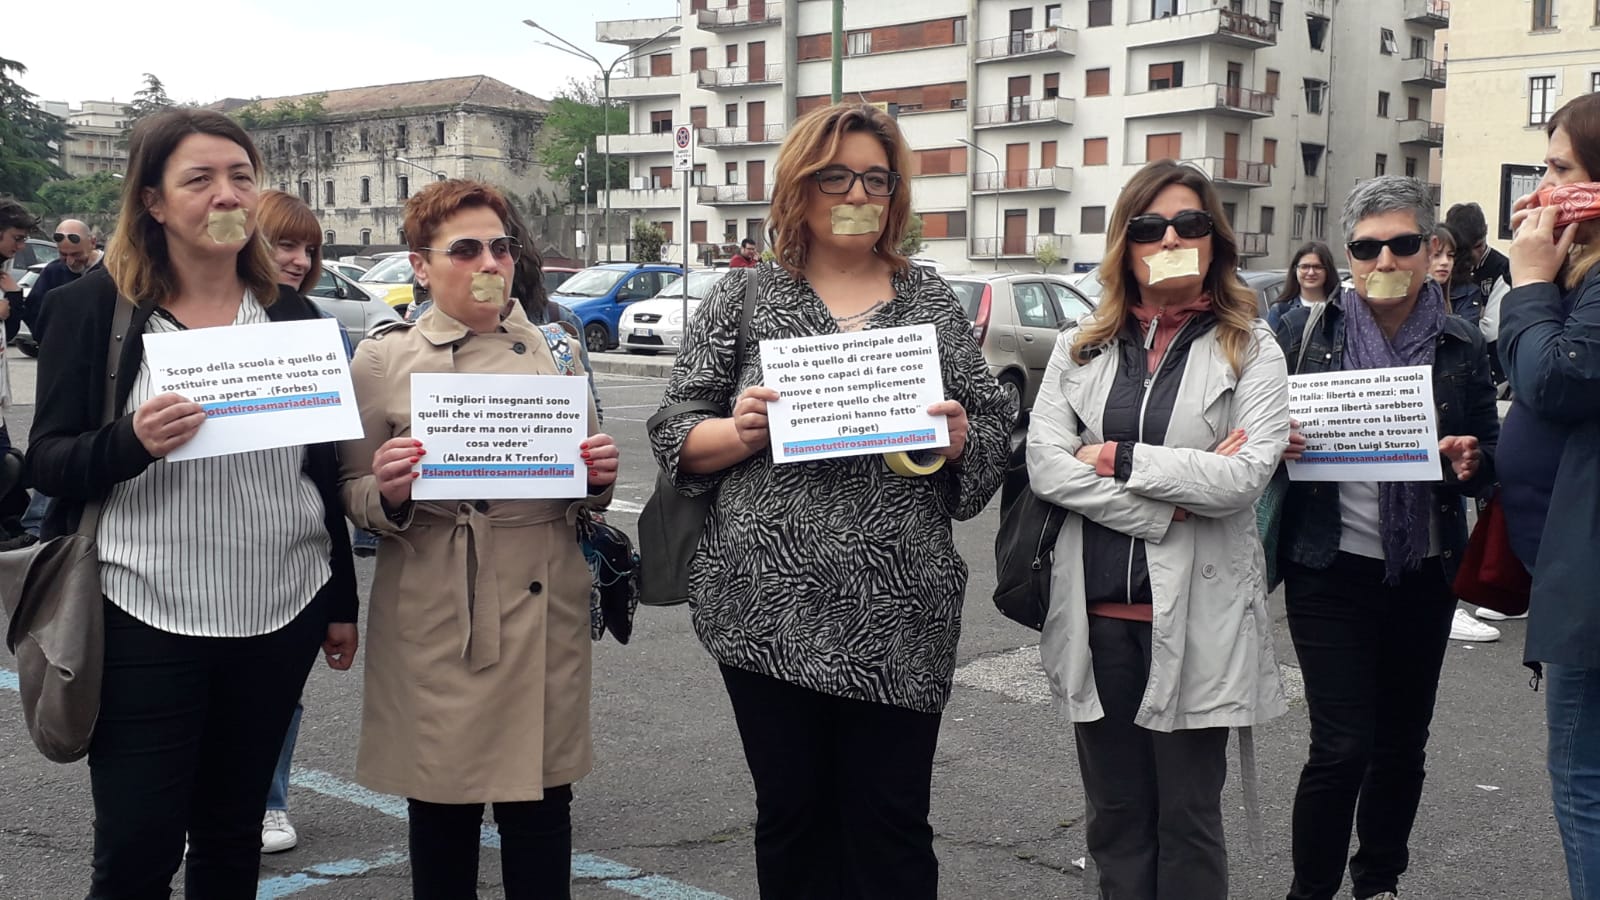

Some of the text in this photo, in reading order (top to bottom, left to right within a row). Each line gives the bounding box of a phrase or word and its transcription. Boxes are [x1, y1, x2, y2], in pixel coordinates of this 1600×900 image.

[792, 342, 839, 354] obiettivo
[843, 336, 894, 351] principale
[897, 333, 922, 343] della
[159, 352, 336, 377] "Scopo della scuola è quello di
[767, 346, 932, 370] scuola è quello di creare uomini
[161, 367, 341, 392] sostituire una mente vuota con
[779, 362, 924, 383] che sono capaci di fare cose
[1331, 378, 1371, 386] mancano
[1374, 375, 1391, 383] alla
[1394, 373, 1424, 382] scuola
[194, 383, 318, 402] una aperta" .(Forbes)
[780, 387, 812, 397] nuove
[824, 384, 844, 394] non
[847, 376, 926, 392] semplicemente
[429, 394, 570, 407] "I migliori insegnanti sono
[792, 391, 917, 412] ripetere quello che altre
[1290, 394, 1298, 402] in
[1300, 392, 1324, 401] Italia:
[1326, 390, 1356, 399] libertà
[1366, 388, 1397, 397] mezzi;
[202, 396, 341, 416] otuttirosamariadellaria
[1288, 400, 1423, 415] mezzi senza libertà sarebbero
[418, 409, 580, 421] quelli che vi mostreranno dove
[790, 404, 921, 427] generazioni hanno fatto"
[1300, 417, 1319, 429] pati
[1327, 417, 1361, 426] mentre
[1383, 413, 1392, 423] la
[1394, 412, 1426, 422] libertà
[427, 424, 476, 435] guardare
[499, 426, 518, 434] non
[521, 425, 530, 434] vi
[534, 425, 572, 434] diranno
[838, 423, 879, 436] (Piaget)
[1348, 428, 1376, 437] anche
[1387, 426, 1423, 435] trovare
[466, 438, 533, 448] cosa vedere"
[783, 432, 936, 454] #siamotuttirosamariadellaria
[1334, 441, 1356, 452] (Don
[1359, 441, 1382, 452] Luigi
[1384, 440, 1420, 449] Sturzo)
[443, 453, 558, 463] (Alexandra K Trenfor)
[422, 467, 574, 477] #siamotuttirosamariadellaria
